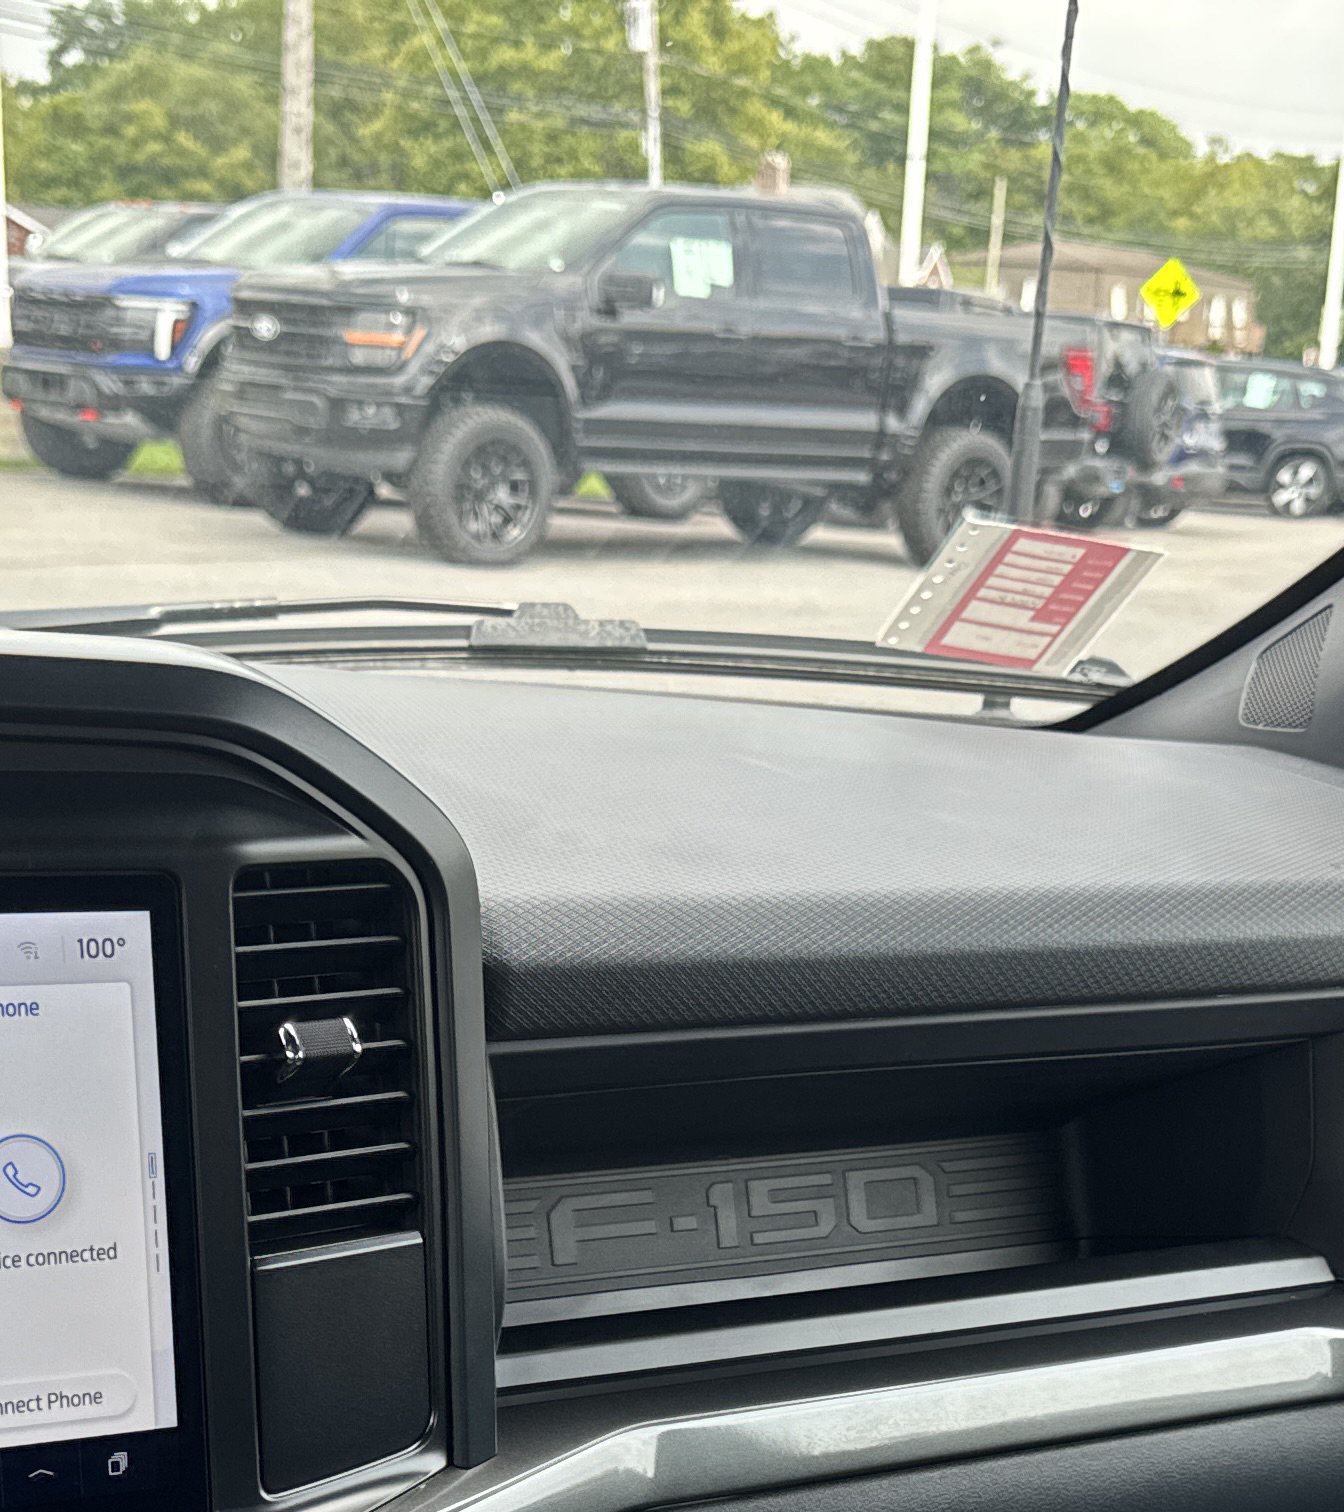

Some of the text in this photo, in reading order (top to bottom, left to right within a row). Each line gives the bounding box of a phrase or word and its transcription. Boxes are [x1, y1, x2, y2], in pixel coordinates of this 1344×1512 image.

[77, 937, 126, 960] 100°
[547, 1165, 937, 1267] F-150
[26, 1243, 118, 1268] connected
[46, 1388, 103, 1410] Phone
